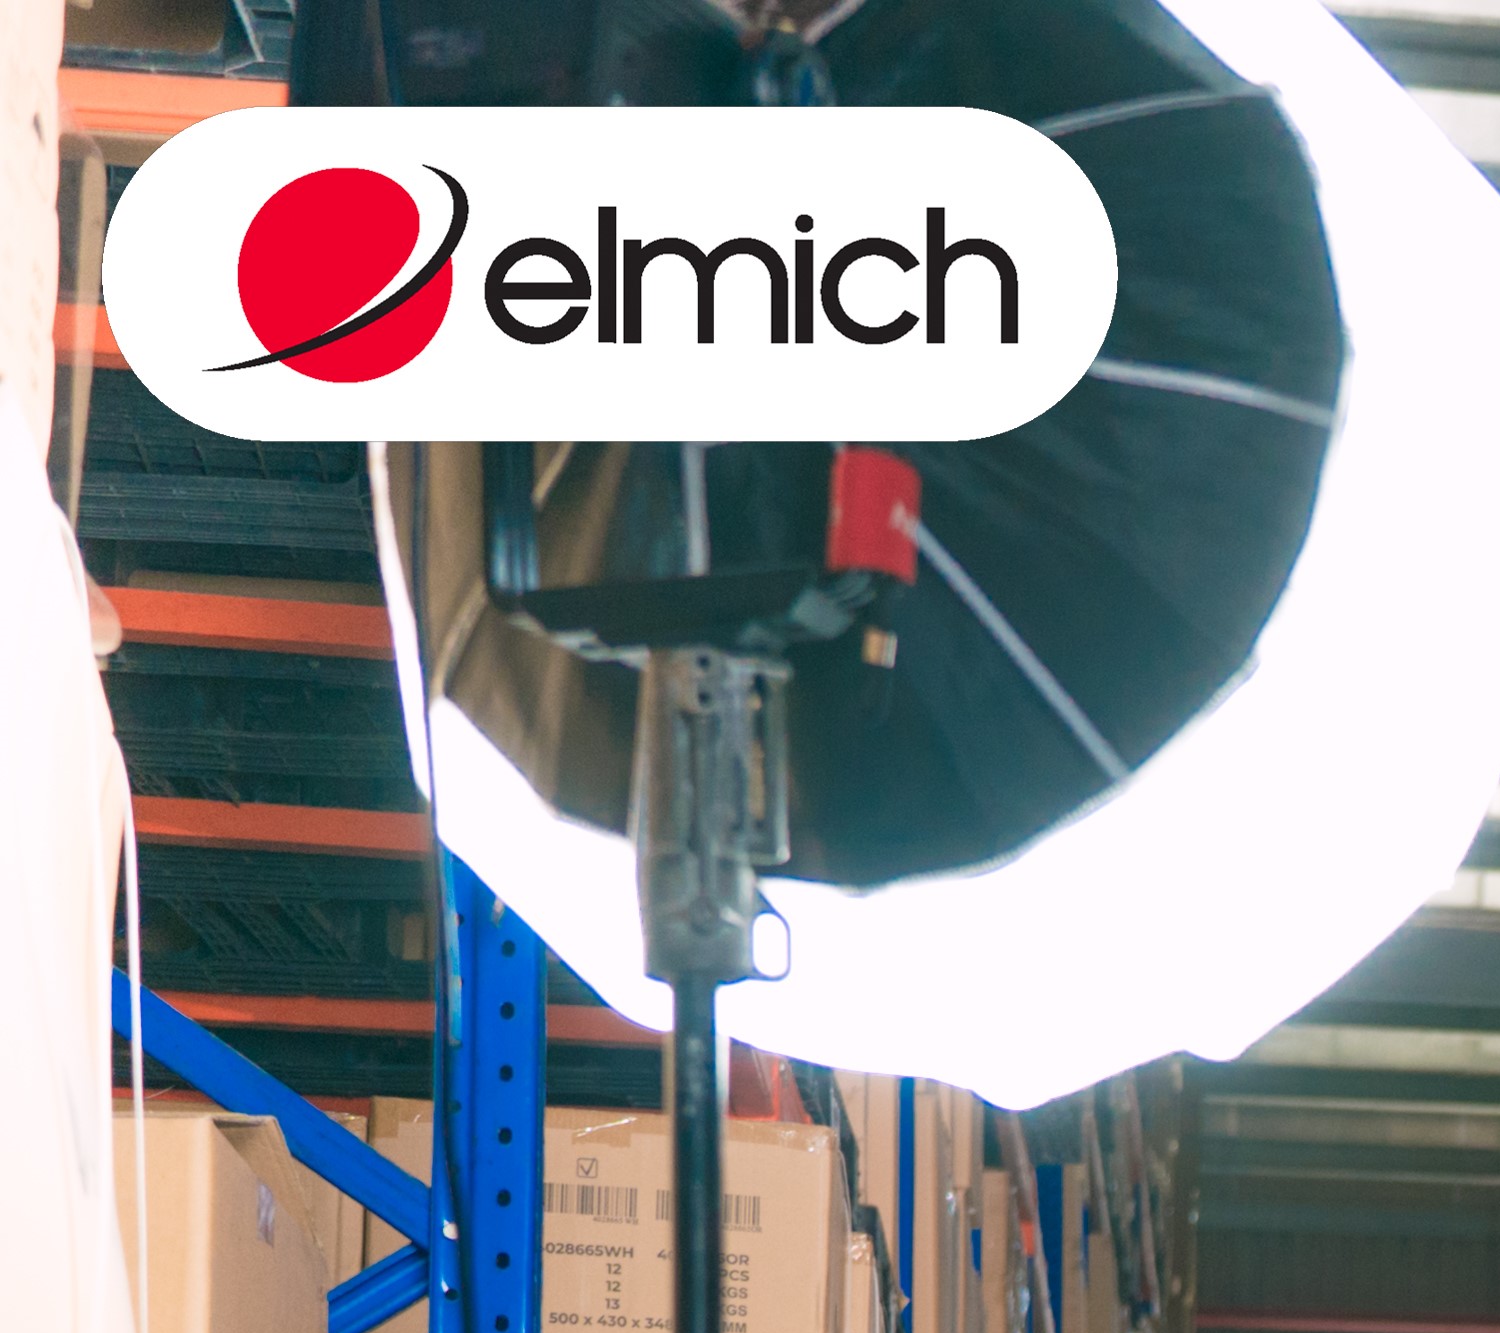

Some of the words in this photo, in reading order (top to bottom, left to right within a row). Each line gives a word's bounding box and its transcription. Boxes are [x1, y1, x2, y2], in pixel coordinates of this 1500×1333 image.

[543, 1243, 634, 1258] 028665WH
[606, 1263, 622, 1275] 12
[606, 1281, 621, 1293] 12
[605, 1298, 620, 1310] 13
[549, 1312, 579, 1326] 500
[583, 1315, 592, 1326] x
[597, 1315, 627, 1328] 430
[632, 1319, 640, 1328] x
